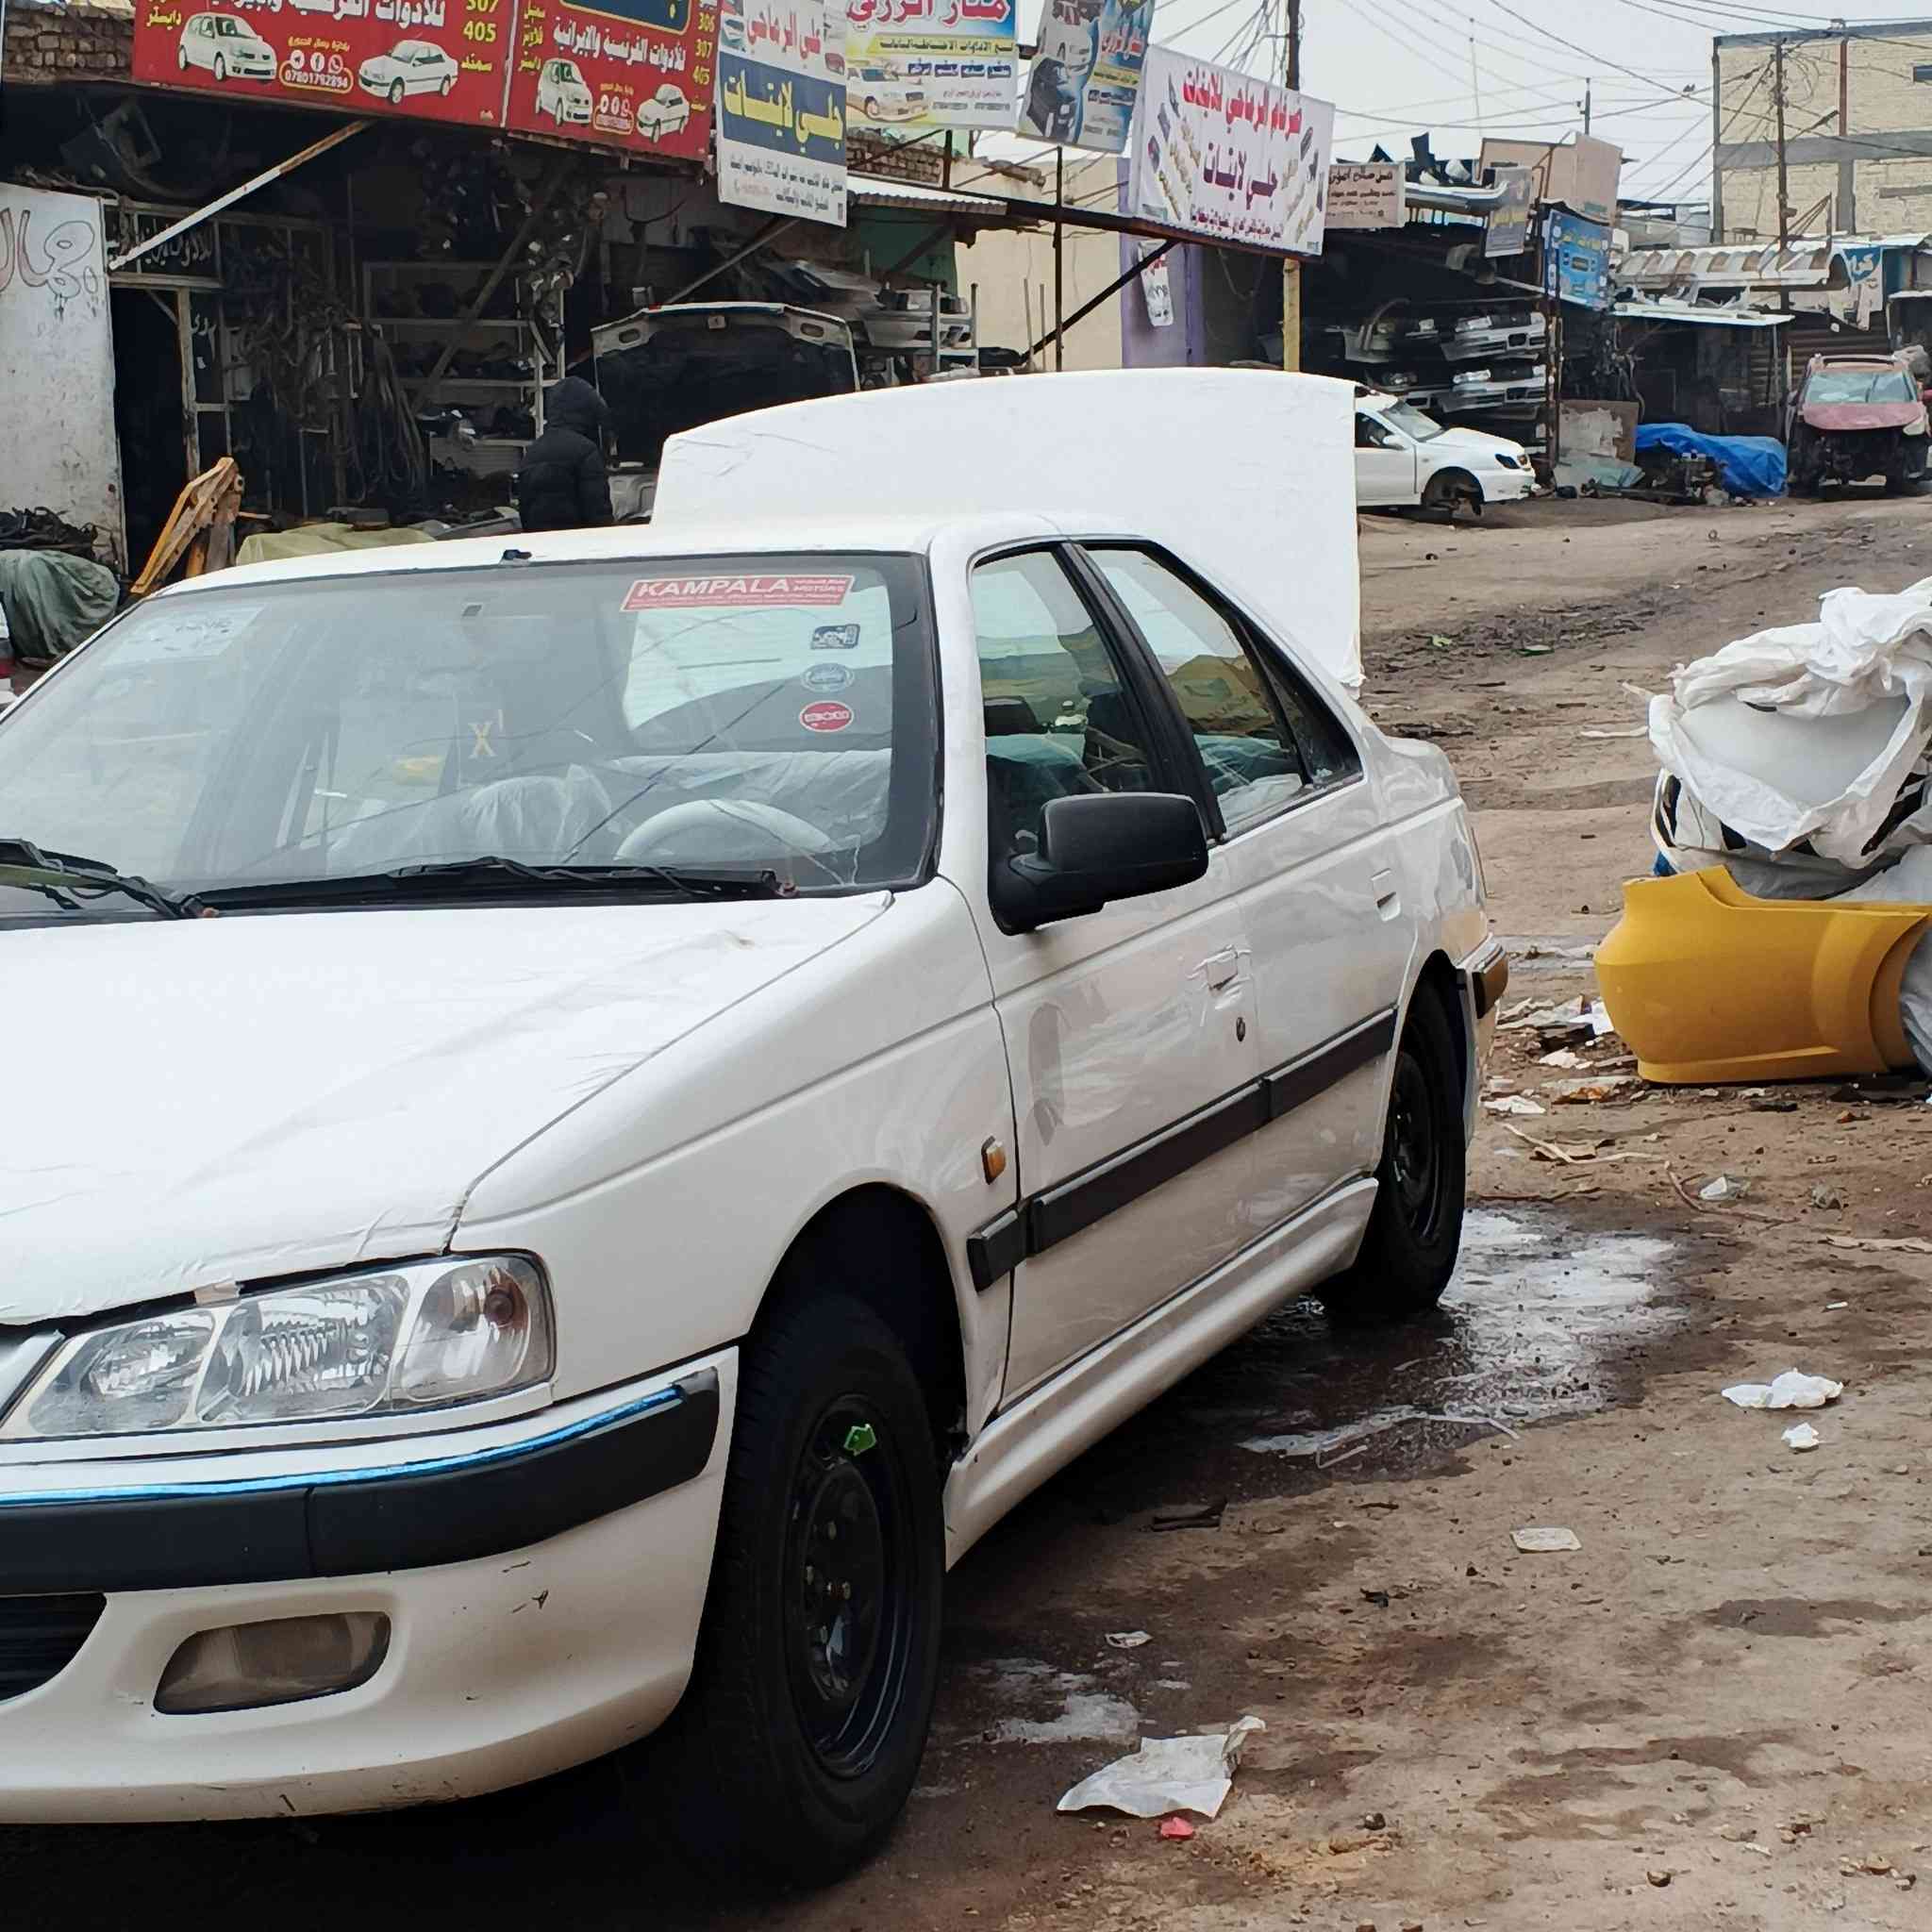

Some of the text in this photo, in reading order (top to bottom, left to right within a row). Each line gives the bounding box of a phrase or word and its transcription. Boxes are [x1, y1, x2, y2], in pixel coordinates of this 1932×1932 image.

[463, 21, 497, 42] 405
[795, 92, 843, 153] جلي
[1244, 158, 1278, 210] جلي
[636, 577, 790, 597] KAMPALA
